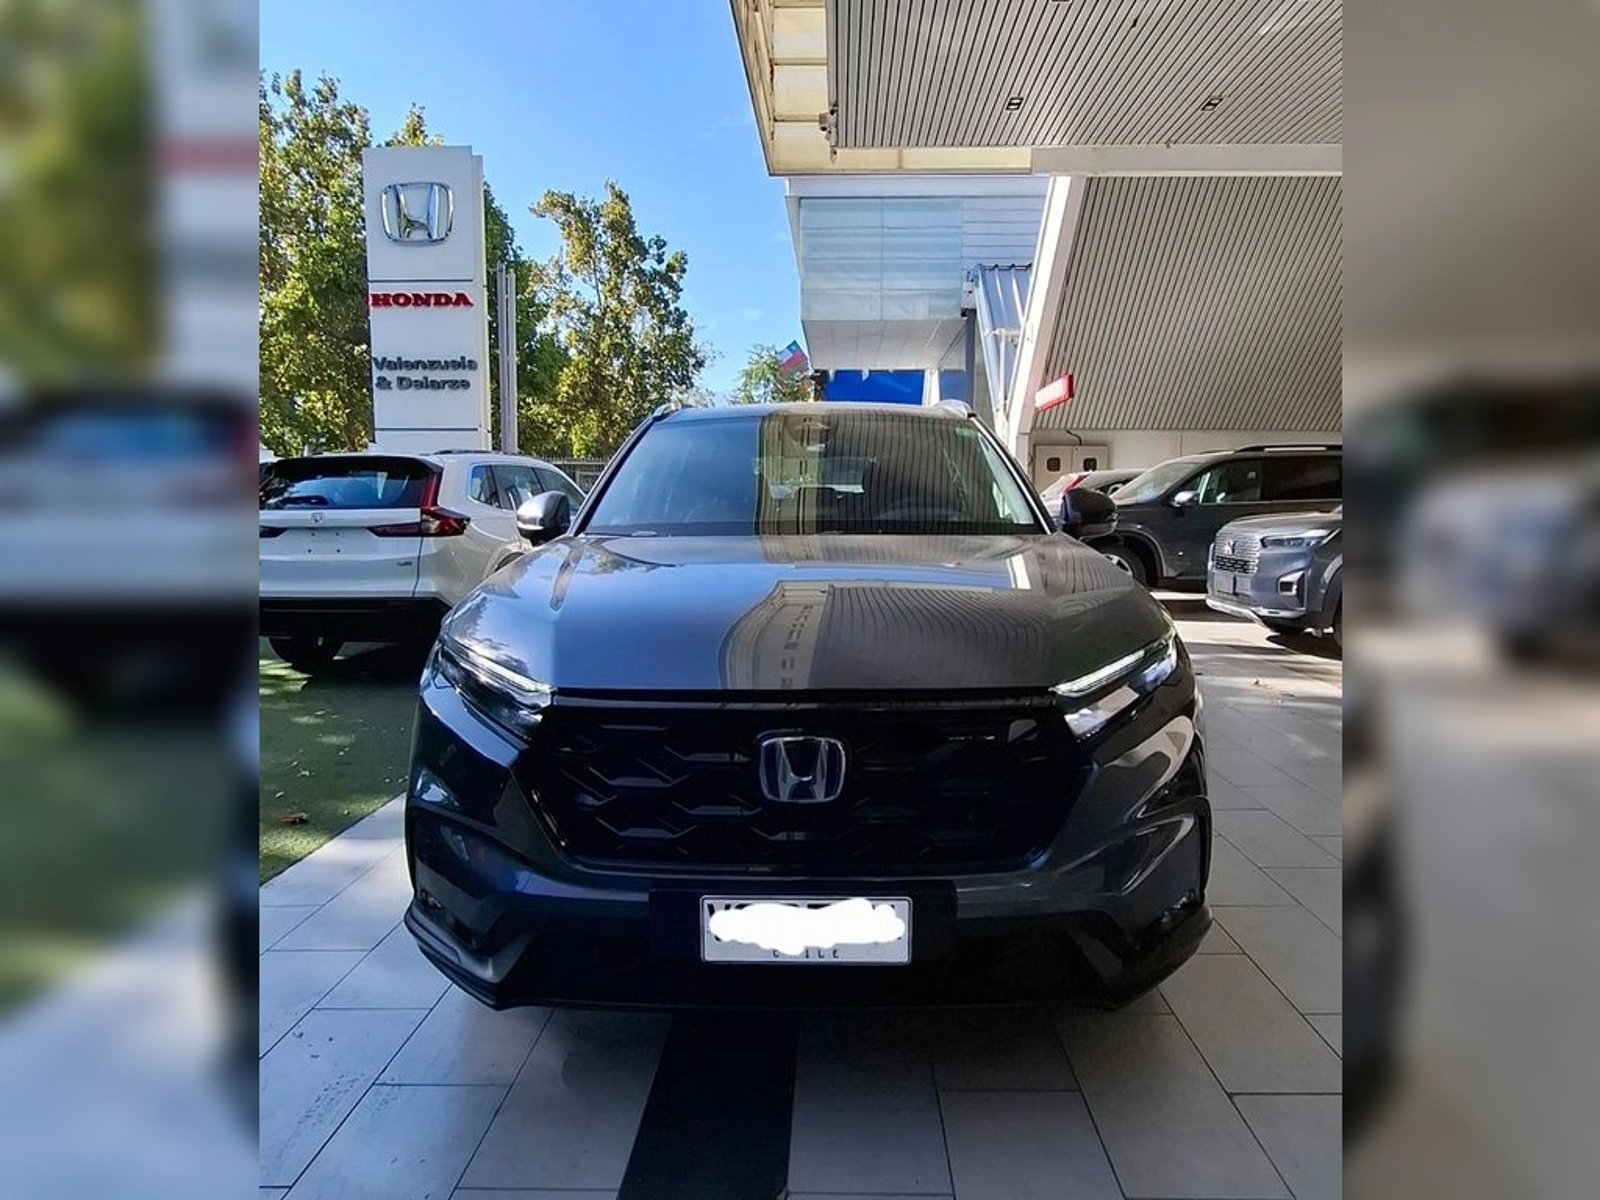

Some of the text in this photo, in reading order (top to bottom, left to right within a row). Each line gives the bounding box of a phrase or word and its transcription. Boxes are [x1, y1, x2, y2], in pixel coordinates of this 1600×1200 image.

[370, 292, 474, 307] HONDA
[372, 355, 478, 371] Valenzuela
[375, 376, 470, 390] & Delarze
[772, 949, 840, 959] CILE
